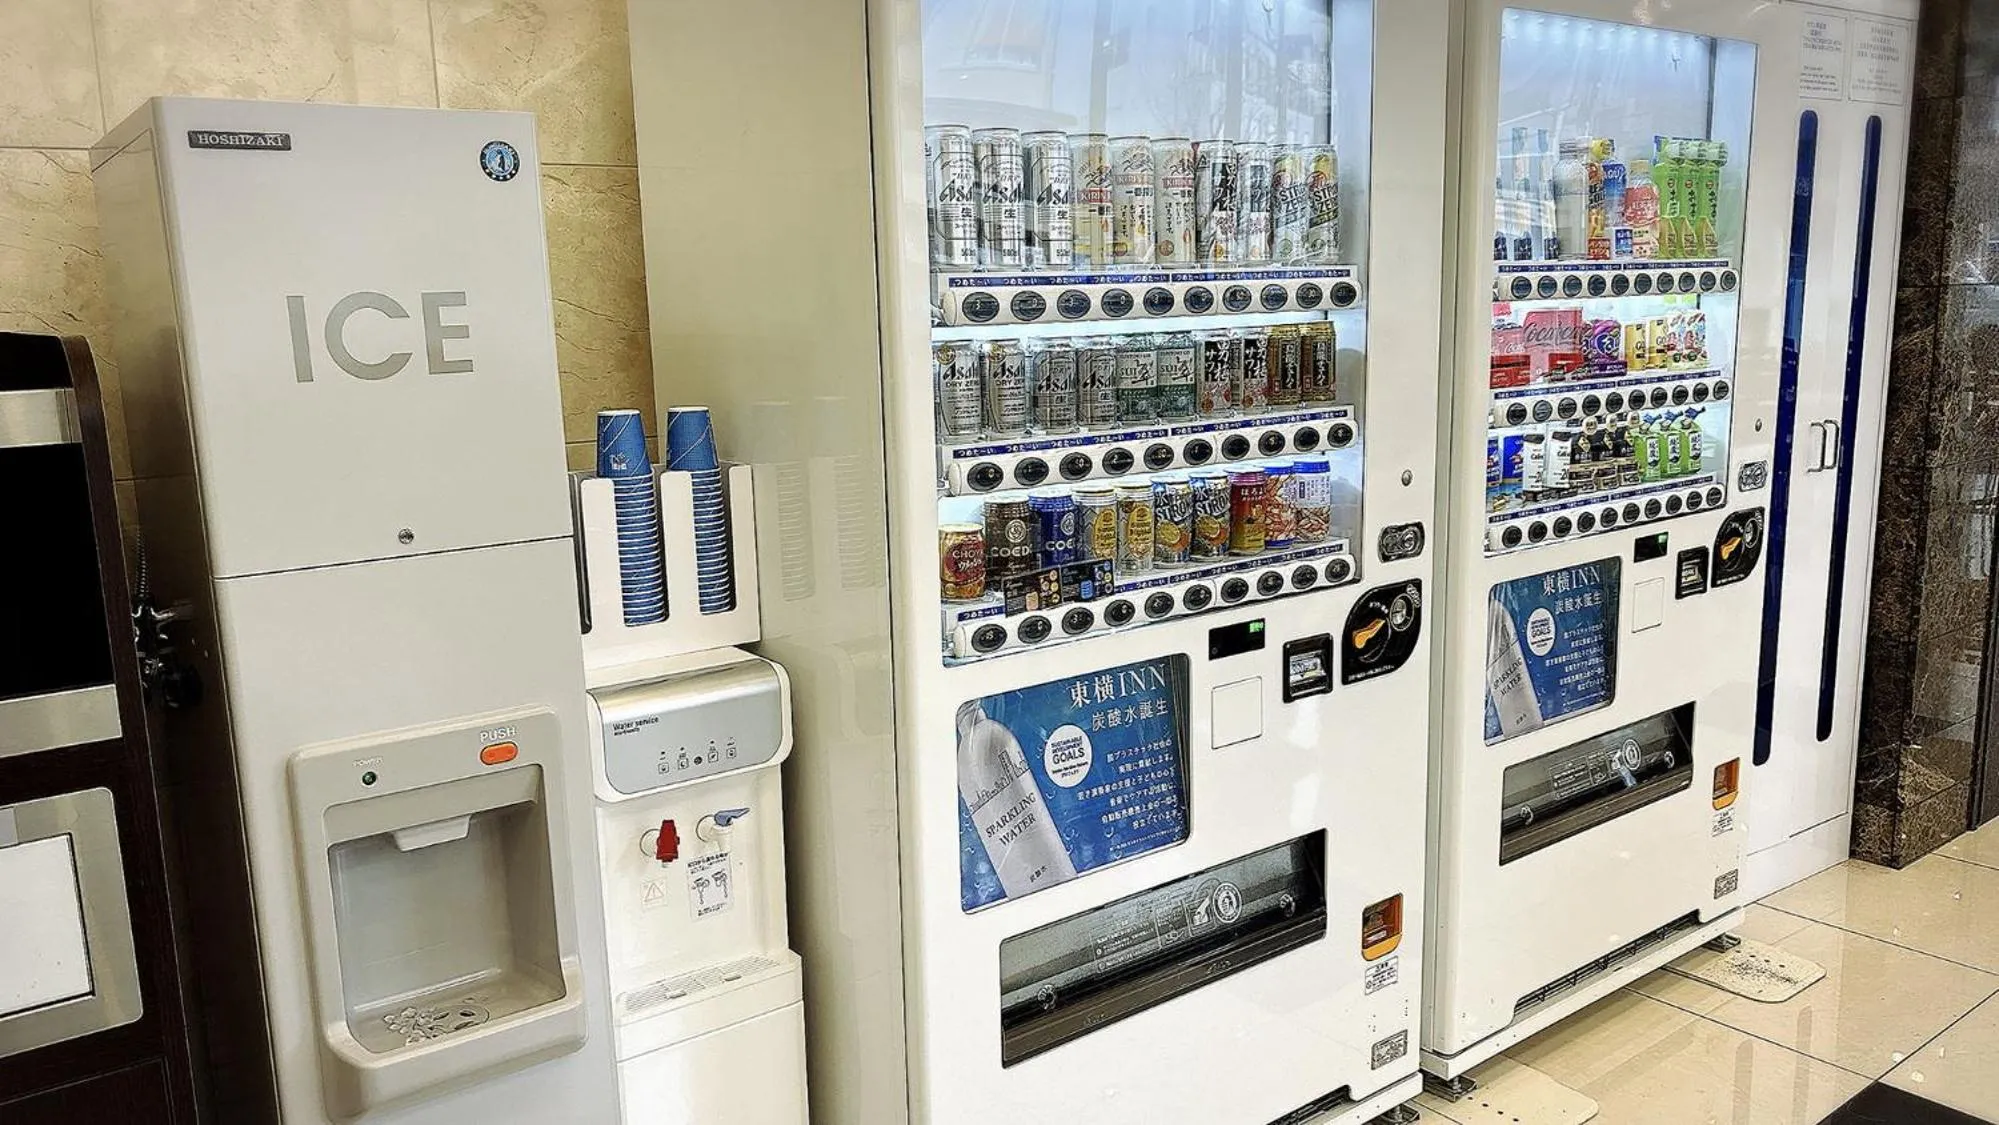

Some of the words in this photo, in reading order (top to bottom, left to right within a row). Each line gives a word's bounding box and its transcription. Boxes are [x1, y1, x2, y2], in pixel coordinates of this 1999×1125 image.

[197, 133, 283, 146] HOSHIZAKI
[286, 291, 474, 383] ICE
[1161, 365, 1178, 373] SUI
[1066, 663, 1167, 711] 東横INN
[613, 720, 634, 731] Water
[635, 716, 659, 727] service
[1092, 697, 1168, 732] 炭酸水誕生
[480, 727, 516, 743] PUSH
[1053, 747, 1085, 765] GOALS
[986, 792, 1036, 838] SPARKLING
[999, 813, 1036, 846] WATER
